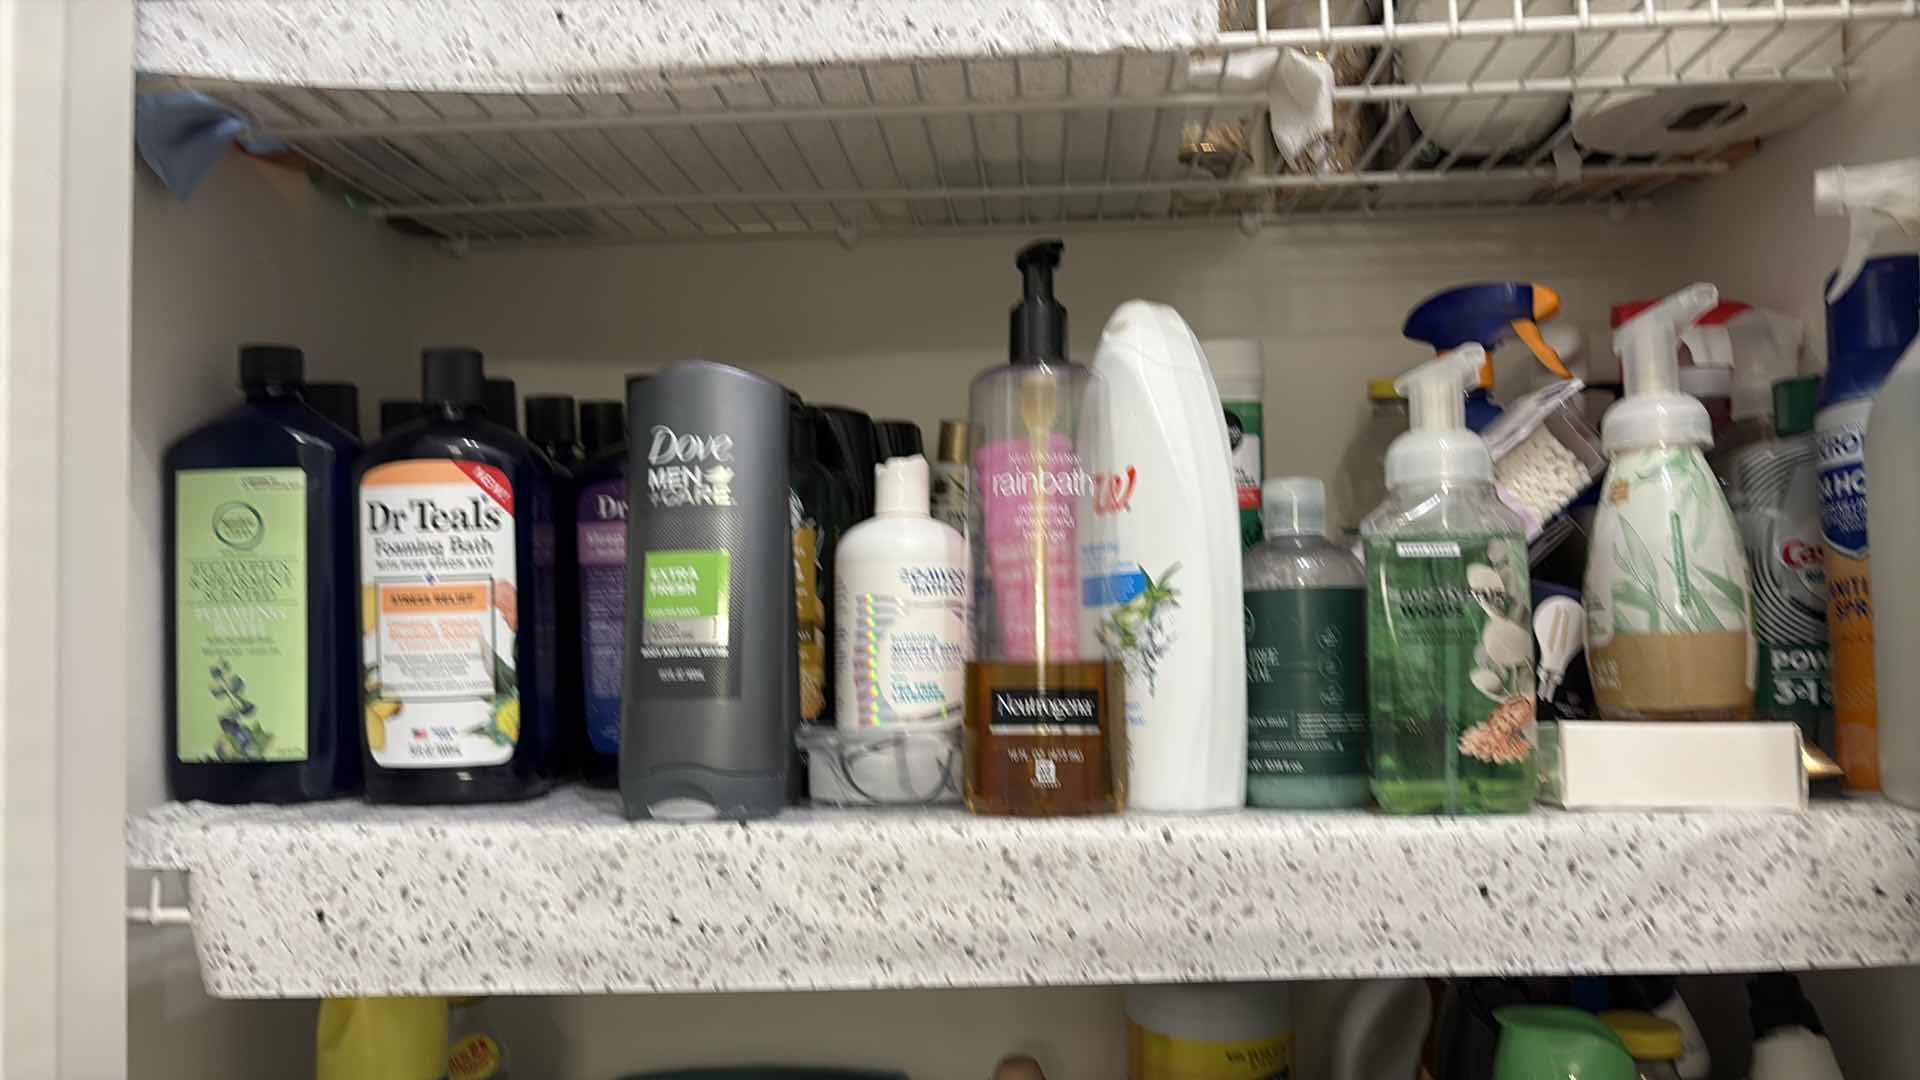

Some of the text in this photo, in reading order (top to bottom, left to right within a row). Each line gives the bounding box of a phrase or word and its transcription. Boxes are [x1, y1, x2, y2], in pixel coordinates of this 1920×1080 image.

[648, 424, 735, 465] Dove
[648, 465, 703, 492] MEN
[992, 464, 1096, 497] rainbath
[366, 494, 503, 535] Dr Teal's
[596, 494, 628, 519] Dr
[374, 534, 495, 558] Foaming Bath
[997, 692, 1096, 722] Neutrogena
